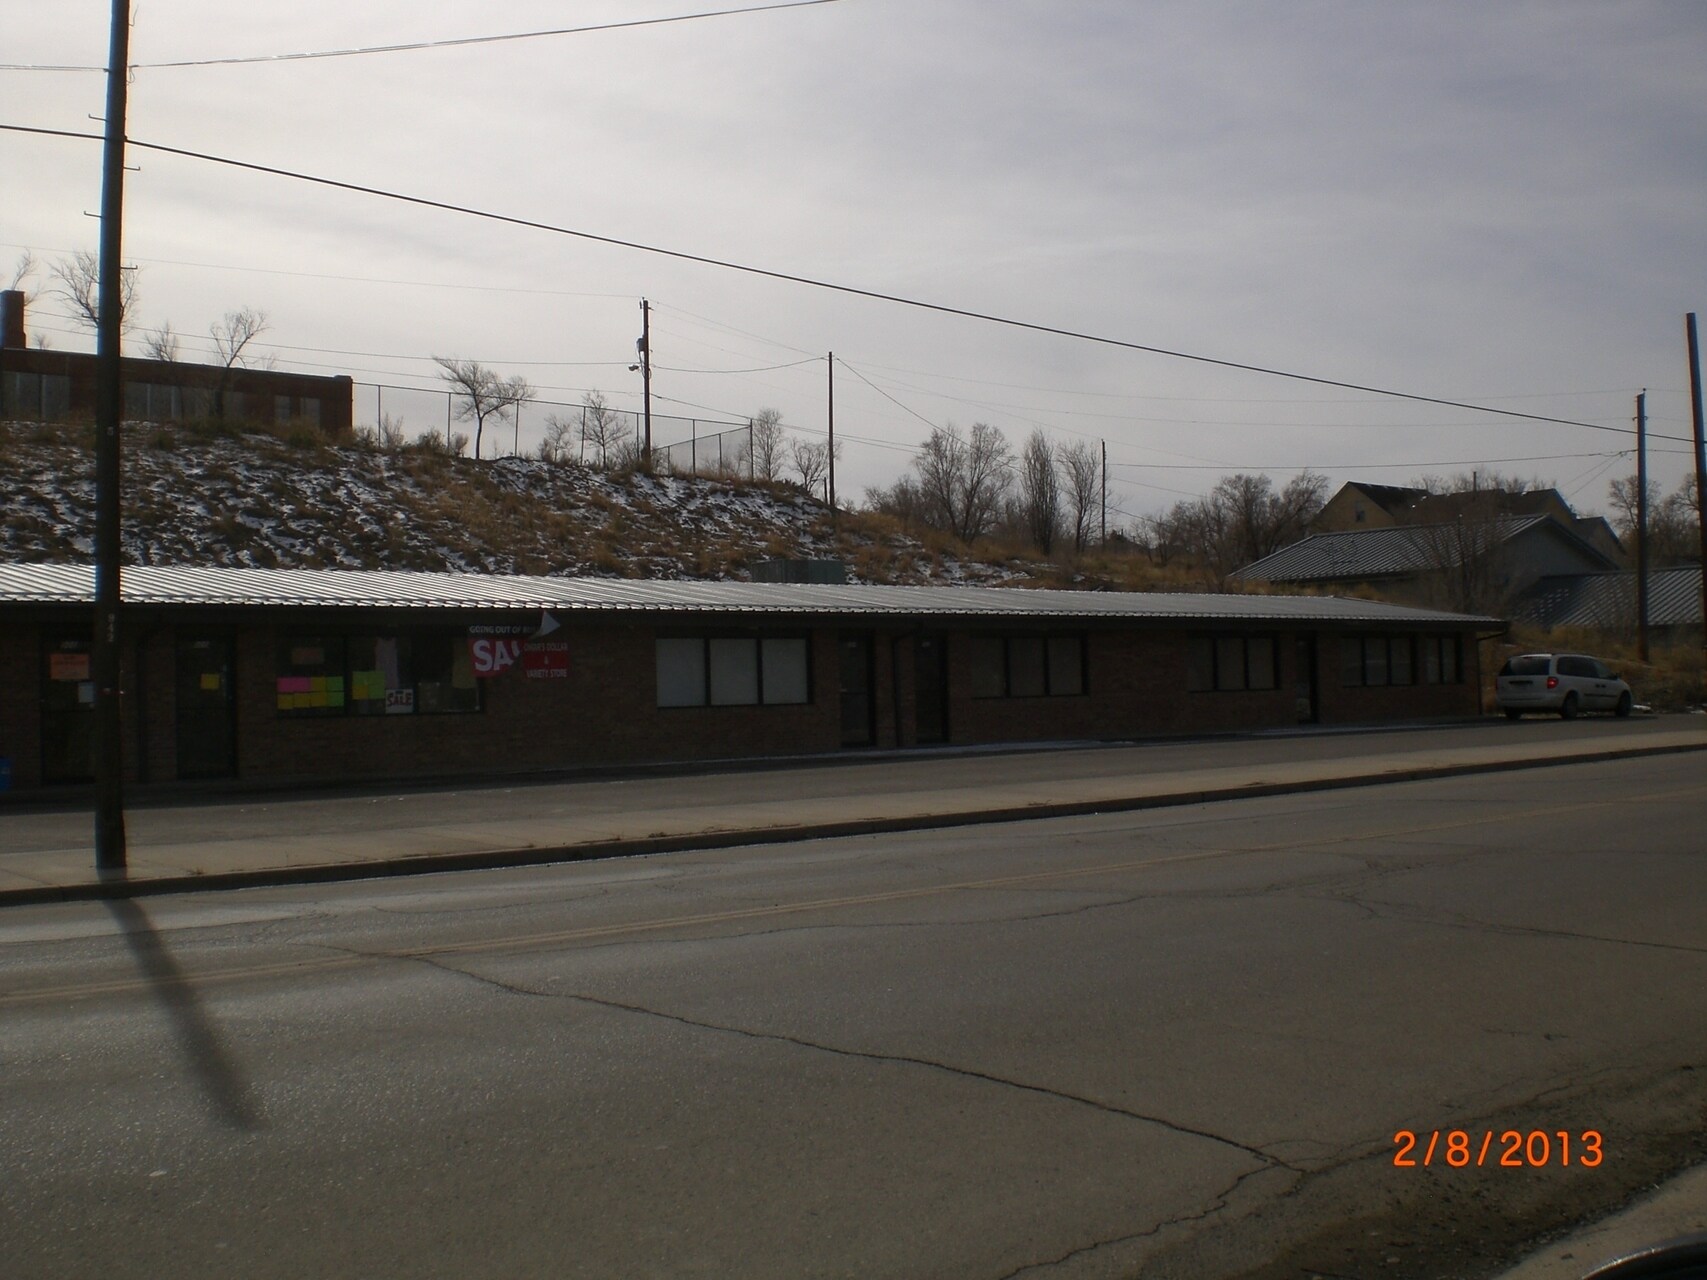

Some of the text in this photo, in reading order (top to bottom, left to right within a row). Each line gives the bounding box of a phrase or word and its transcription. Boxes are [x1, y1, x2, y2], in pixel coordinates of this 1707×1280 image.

[469, 625, 494, 634] GOING
[495, 625, 511, 634] OUT
[512, 625, 521, 634] OF
[526, 668, 568, 678] VARIETY STORE
[387, 692, 413, 707] SALE
